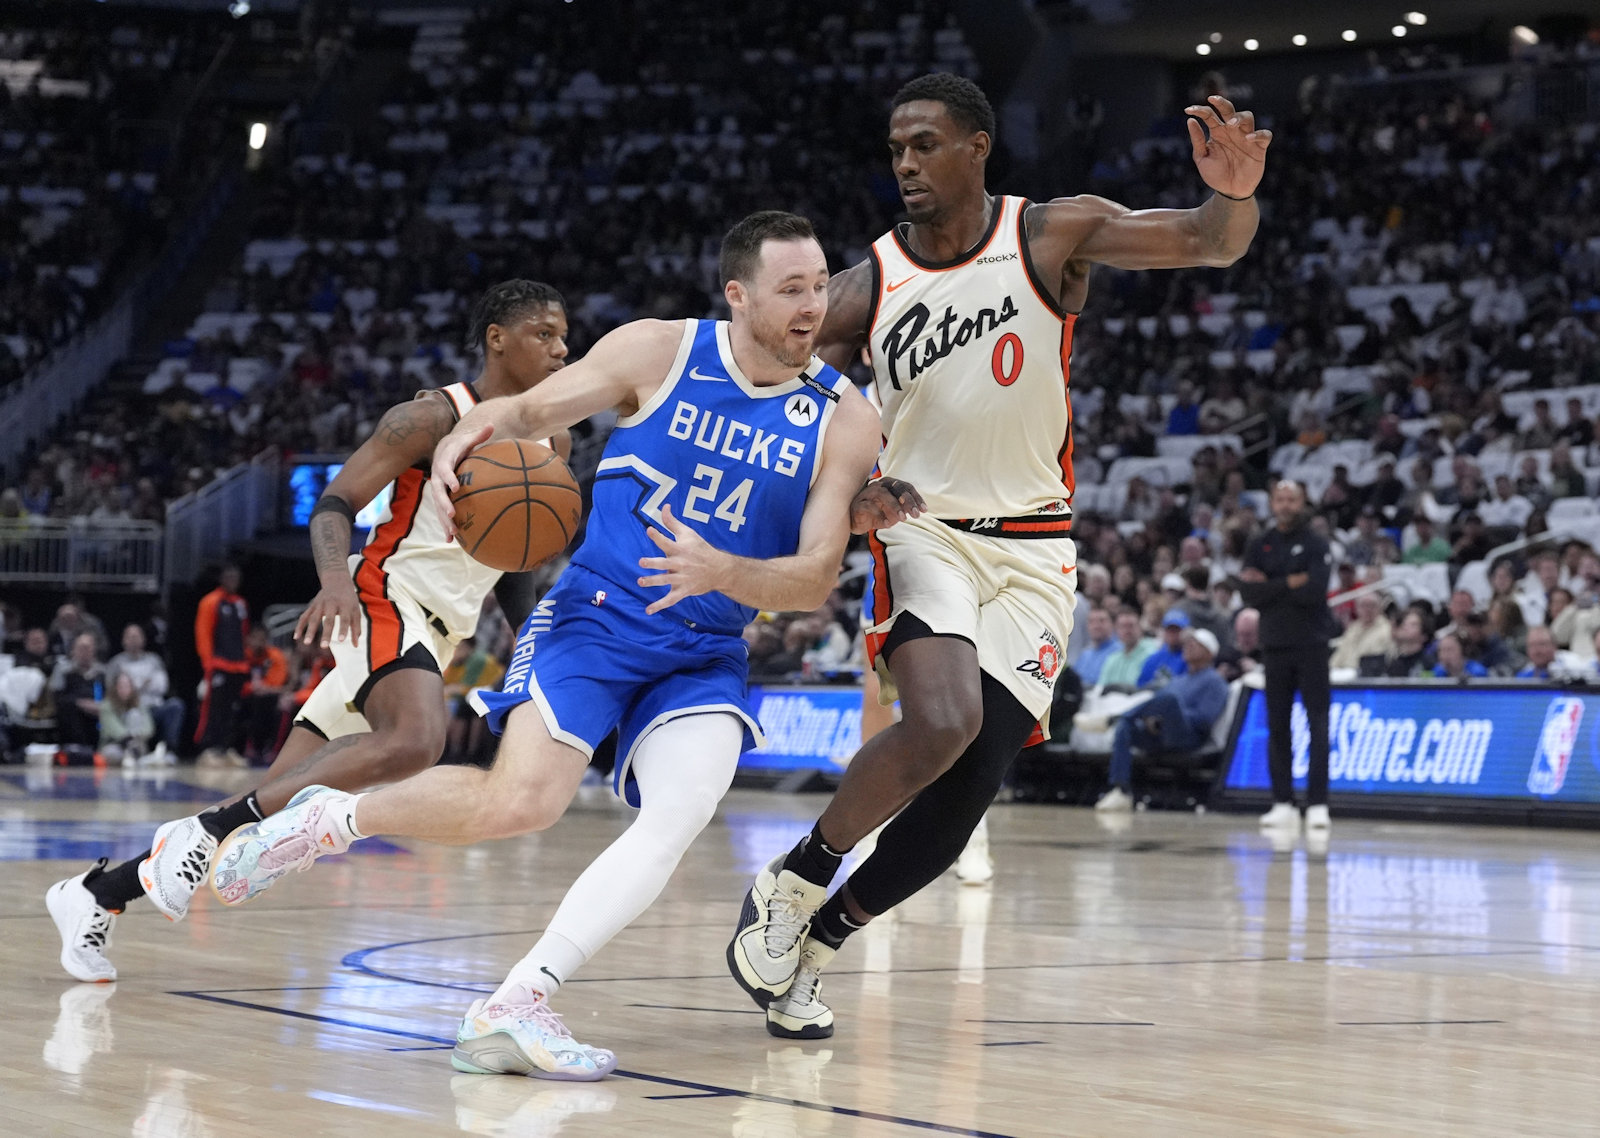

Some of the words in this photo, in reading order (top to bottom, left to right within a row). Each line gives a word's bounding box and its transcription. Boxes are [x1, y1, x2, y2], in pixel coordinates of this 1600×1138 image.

[976, 252, 1018, 265] stockX
[881, 295, 1019, 391] Pistons
[991, 332, 1024, 387] 0
[667, 399, 806, 478] BUCKS
[682, 462, 754, 533] 24
